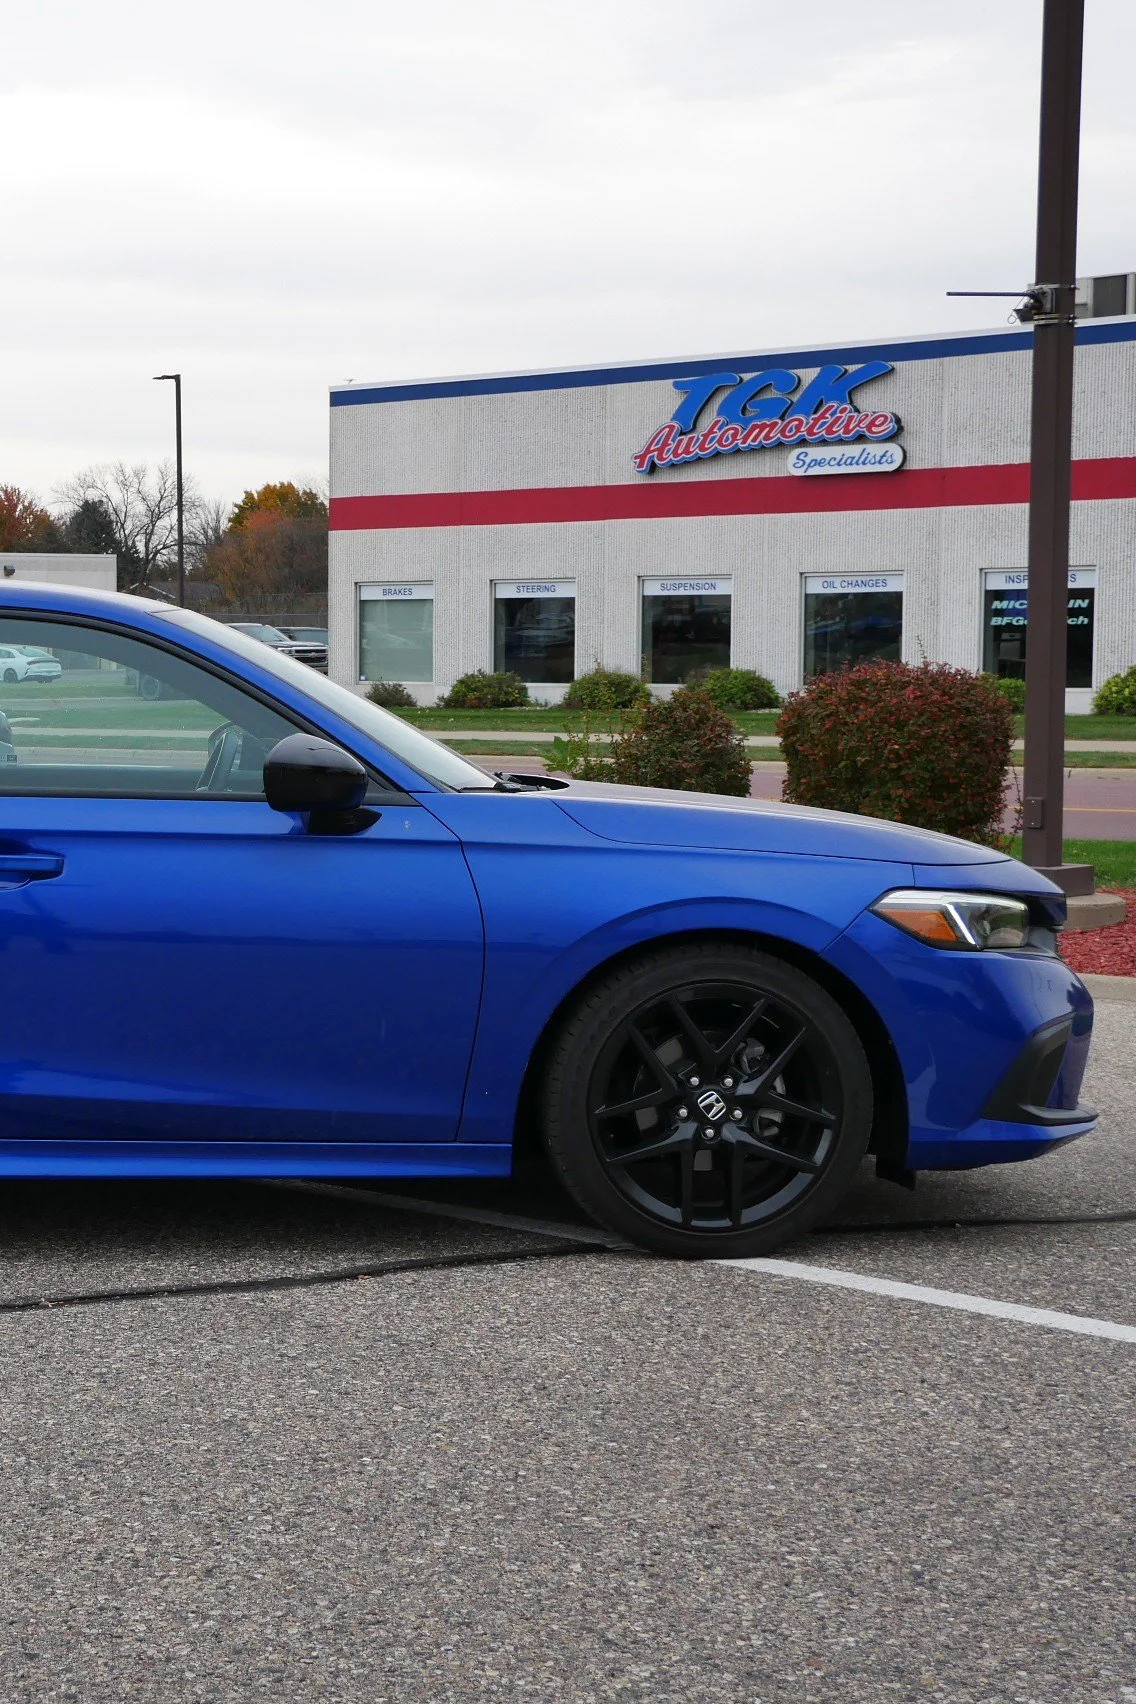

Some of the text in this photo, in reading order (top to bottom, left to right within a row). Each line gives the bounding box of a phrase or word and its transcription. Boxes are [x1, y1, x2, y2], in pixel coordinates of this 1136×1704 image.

[671, 360, 894, 433] TGK
[631, 401, 900, 475] Automotive
[792, 446, 897, 474] Specialists
[659, 582, 717, 592] SUSPENSION
[821, 578, 888, 589] OIL CHANGES
[382, 587, 413, 596] BRAKES
[515, 584, 556, 594] STEERING
[991, 599, 1089, 609] MICIN
